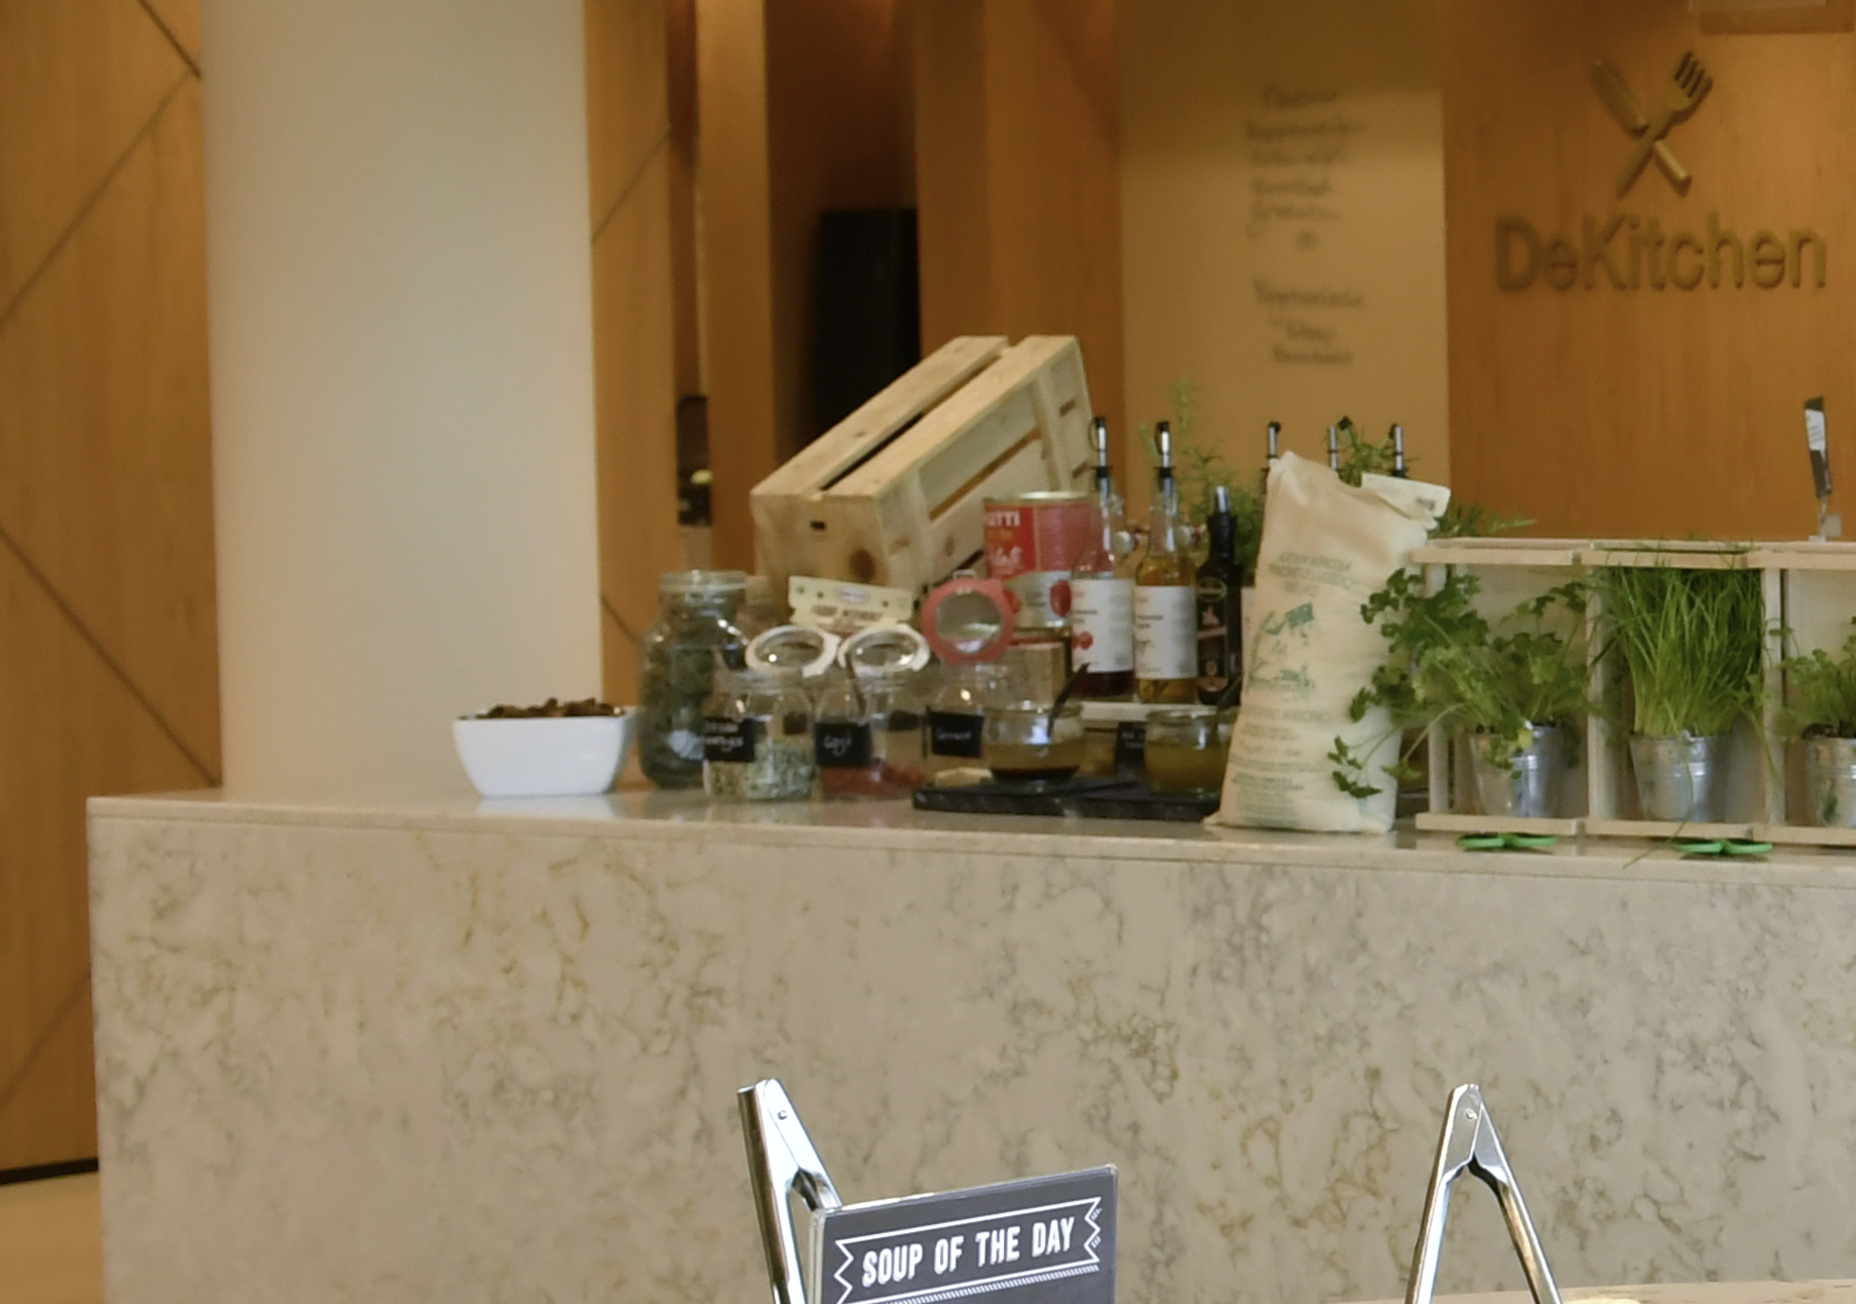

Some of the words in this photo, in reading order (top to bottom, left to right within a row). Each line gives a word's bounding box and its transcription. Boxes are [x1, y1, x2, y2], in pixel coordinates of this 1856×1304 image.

[1494, 210, 1827, 292] DeKitchen
[862, 1243, 923, 1287] SOUP
[934, 1235, 964, 1275] OF
[975, 1225, 1021, 1267] THE
[1032, 1216, 1075, 1257] DAY
